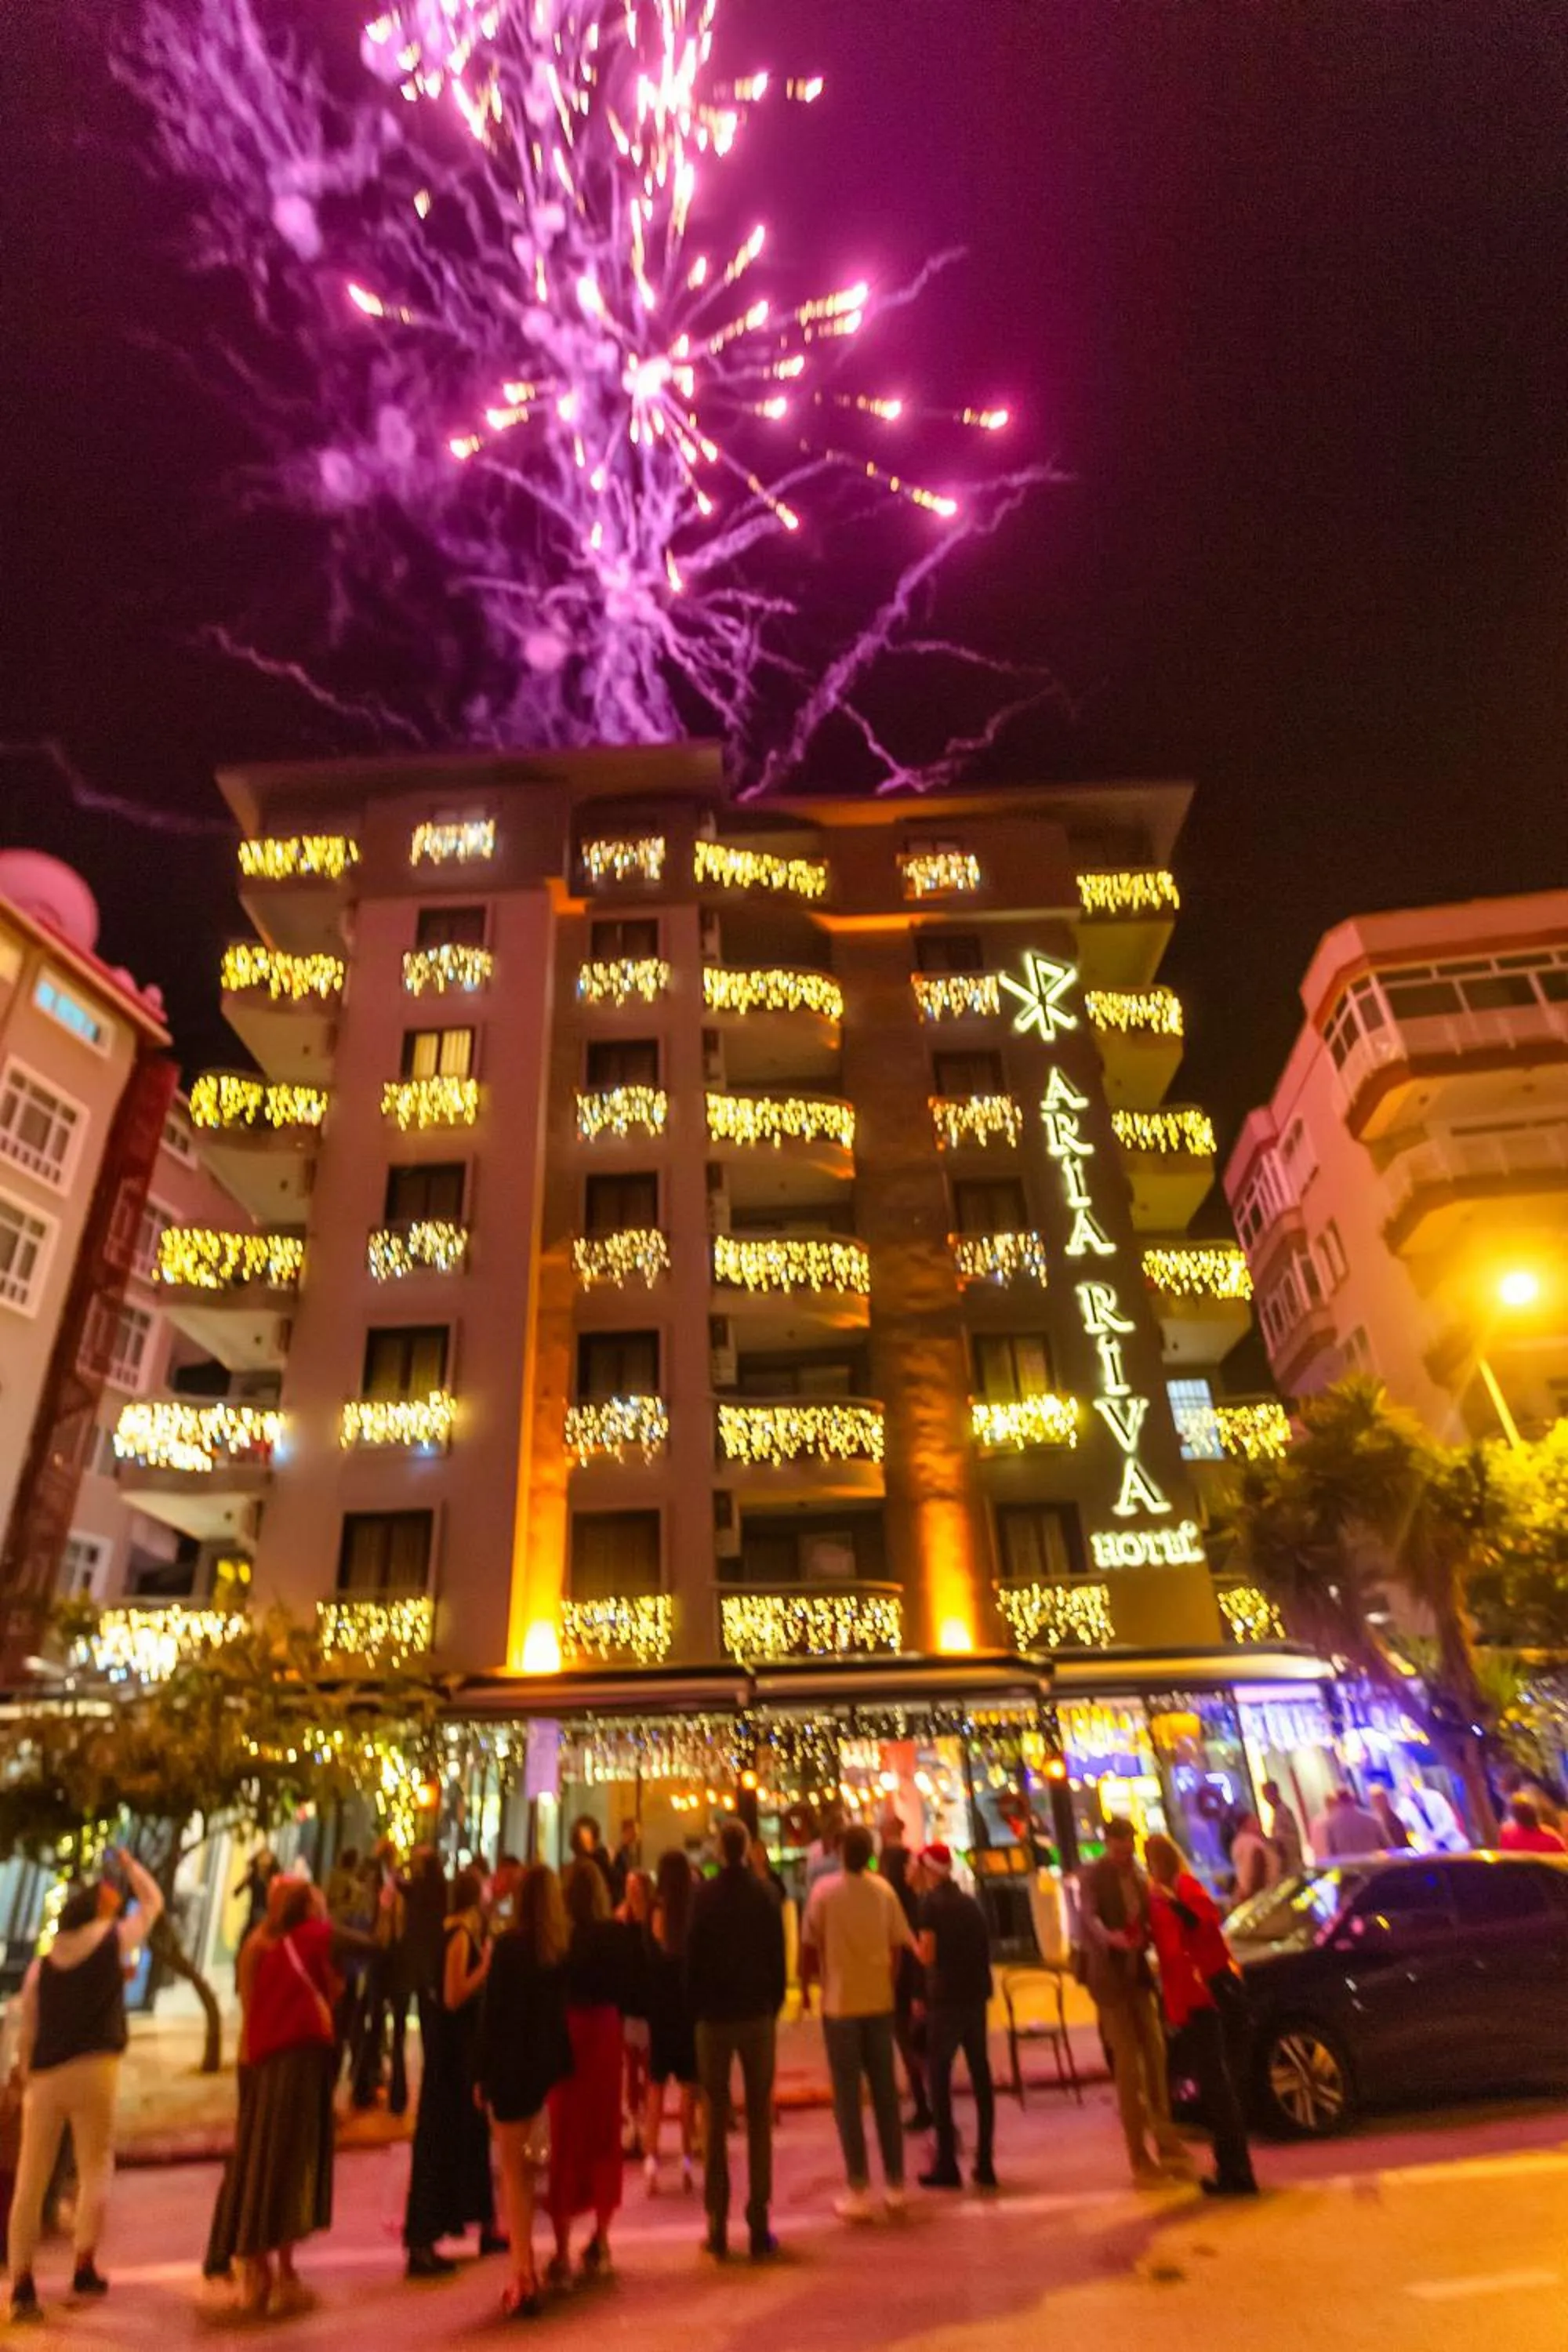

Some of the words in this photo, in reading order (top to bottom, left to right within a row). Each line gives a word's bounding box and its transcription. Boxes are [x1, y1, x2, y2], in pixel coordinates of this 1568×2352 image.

[1040, 1066, 1116, 1256] ARIA
[1076, 1282, 1171, 1516] RIVA
[1090, 1527, 1206, 1569] HOTEL
